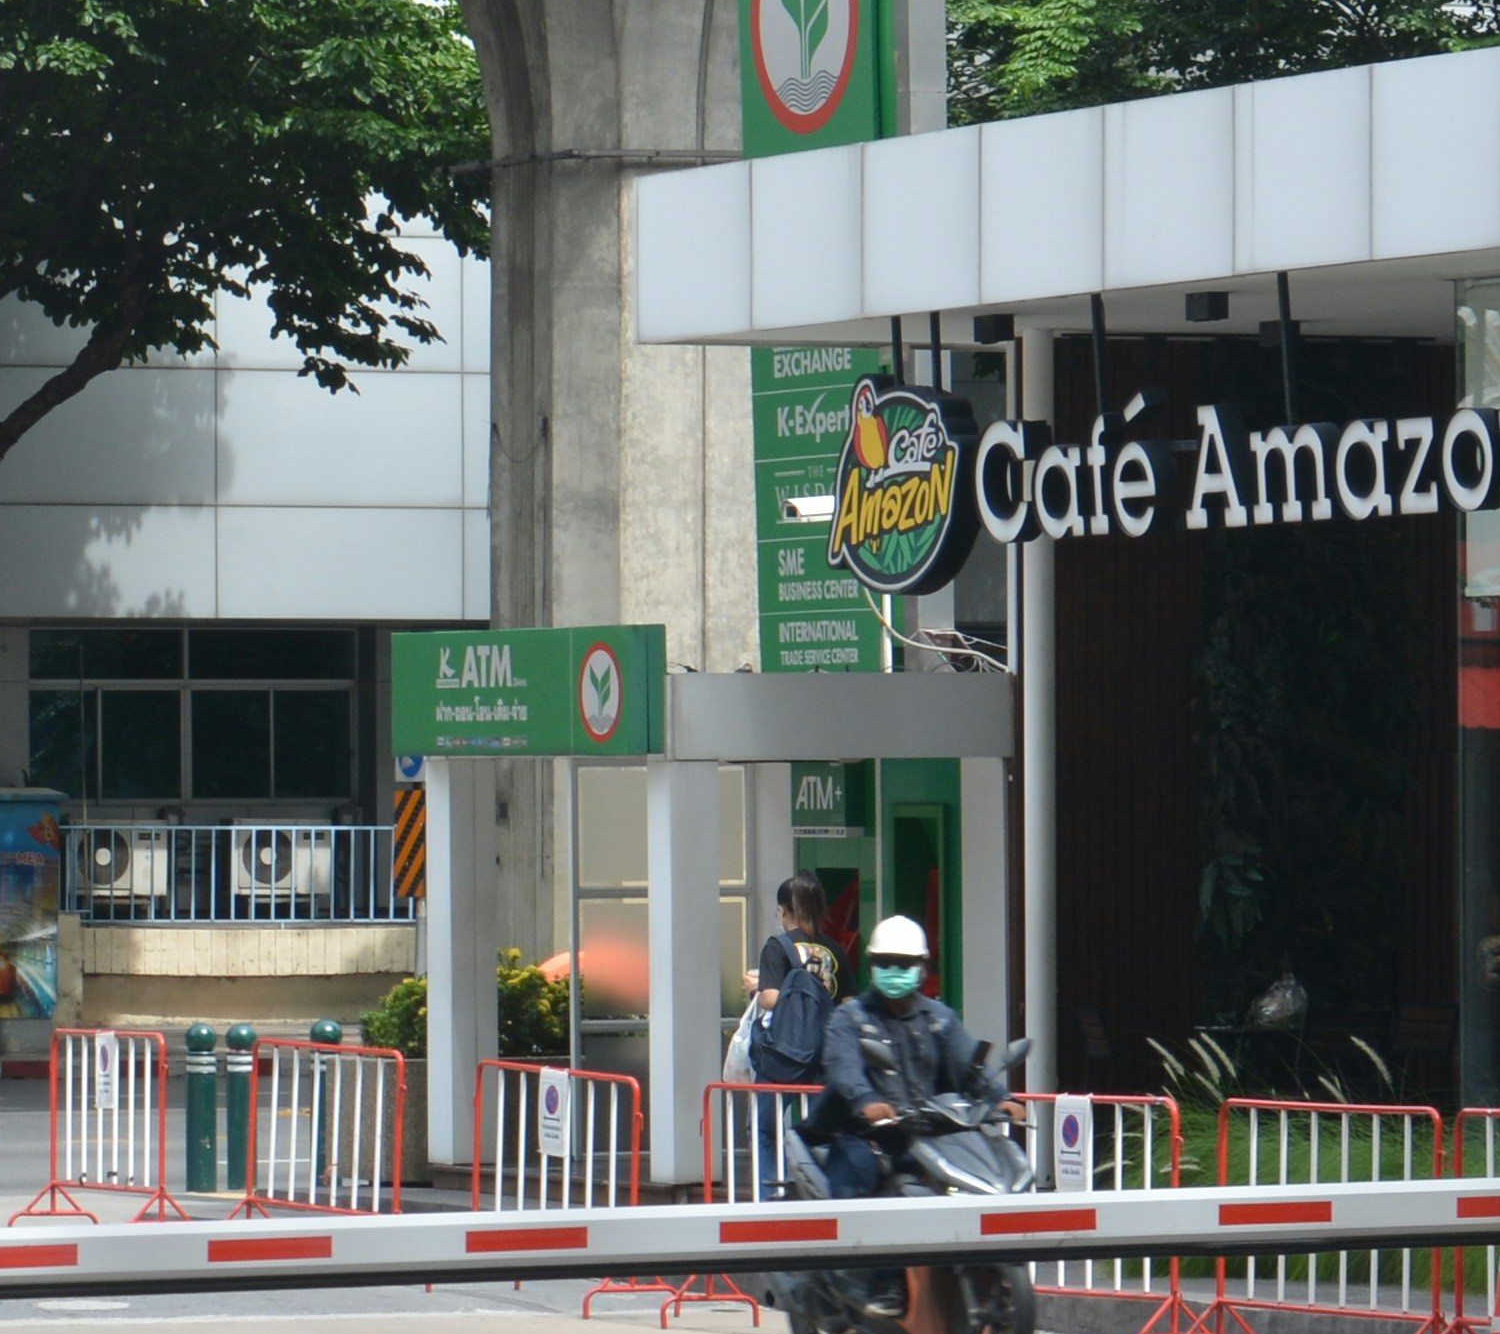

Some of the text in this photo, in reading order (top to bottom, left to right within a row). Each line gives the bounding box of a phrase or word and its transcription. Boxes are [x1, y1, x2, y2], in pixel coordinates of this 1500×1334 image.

[773, 348, 852, 379] EXCHANGE
[777, 392, 850, 443] K-Expert
[807, 465, 824, 479] THE
[976, 393, 1155, 543] Café
[778, 548, 805, 577] SME
[779, 579, 860, 602] BUSINESS CENTER
[779, 620, 859, 643] INTERNATIONAL
[461, 644, 512, 688] ATM
[780, 648, 859, 666] TRADE SERVICE CENTER
